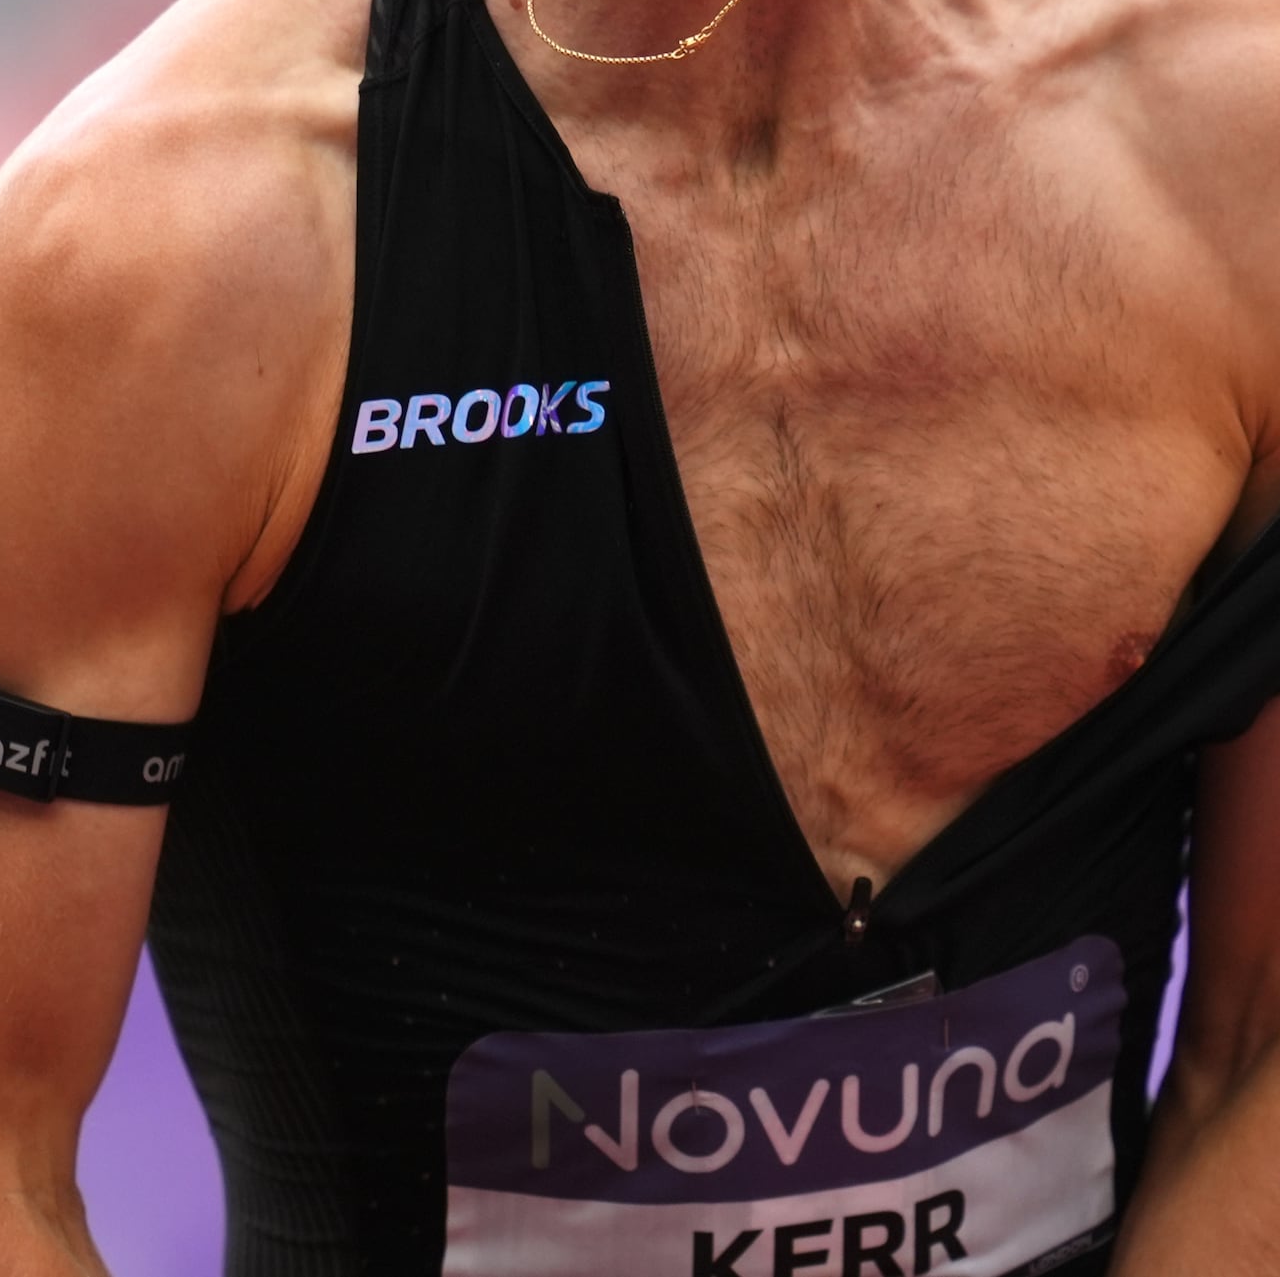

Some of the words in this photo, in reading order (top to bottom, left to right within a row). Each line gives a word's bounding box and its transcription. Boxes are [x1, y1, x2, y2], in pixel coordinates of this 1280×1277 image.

[351, 380, 611, 454] BROOKS
[531, 1012, 1074, 1174] Novuna
[692, 1189, 969, 1277] KERR
